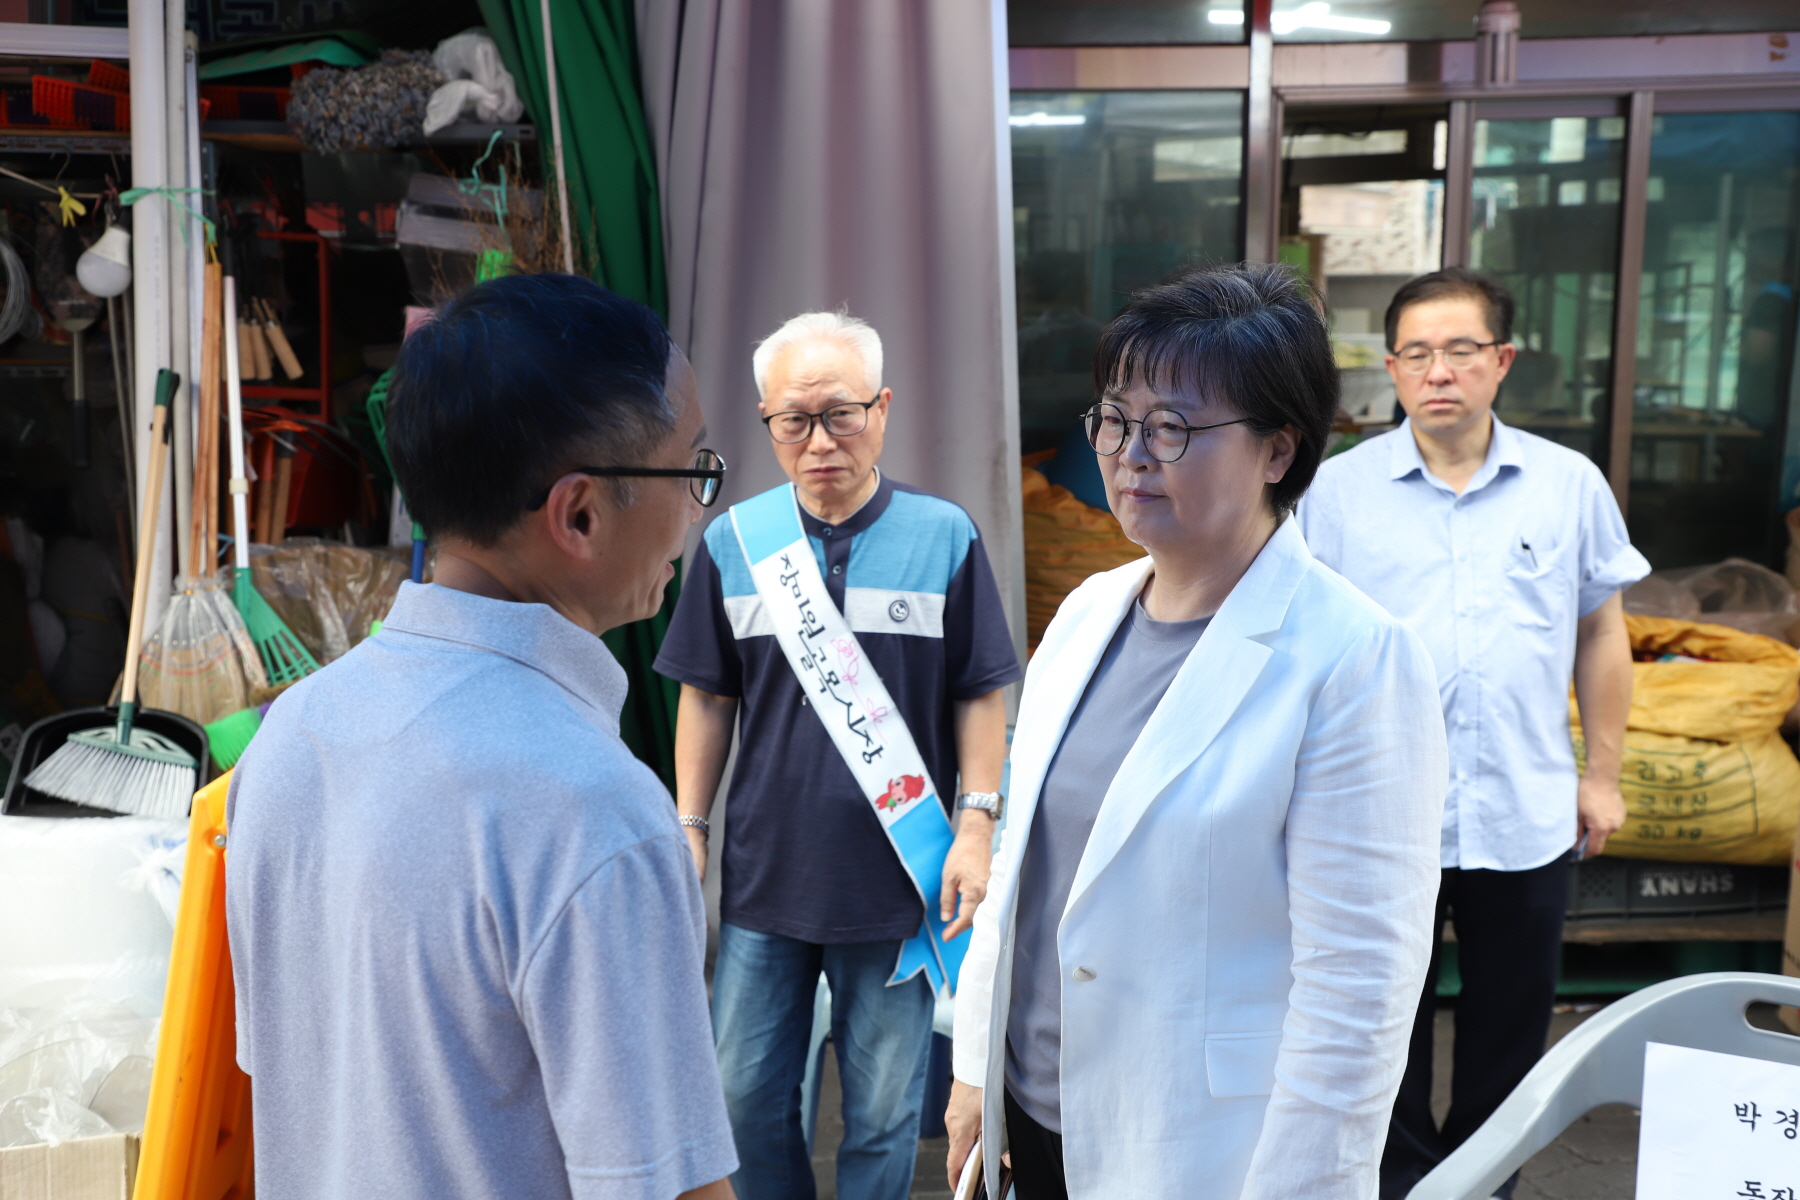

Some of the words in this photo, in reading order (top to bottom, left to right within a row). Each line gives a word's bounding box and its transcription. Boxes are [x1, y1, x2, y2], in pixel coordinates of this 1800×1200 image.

[1637, 823, 1665, 840] 30
[1638, 873, 1735, 897] SHANY
[1733, 1101, 1762, 1133] 박
[1772, 1108, 1799, 1140] 경
